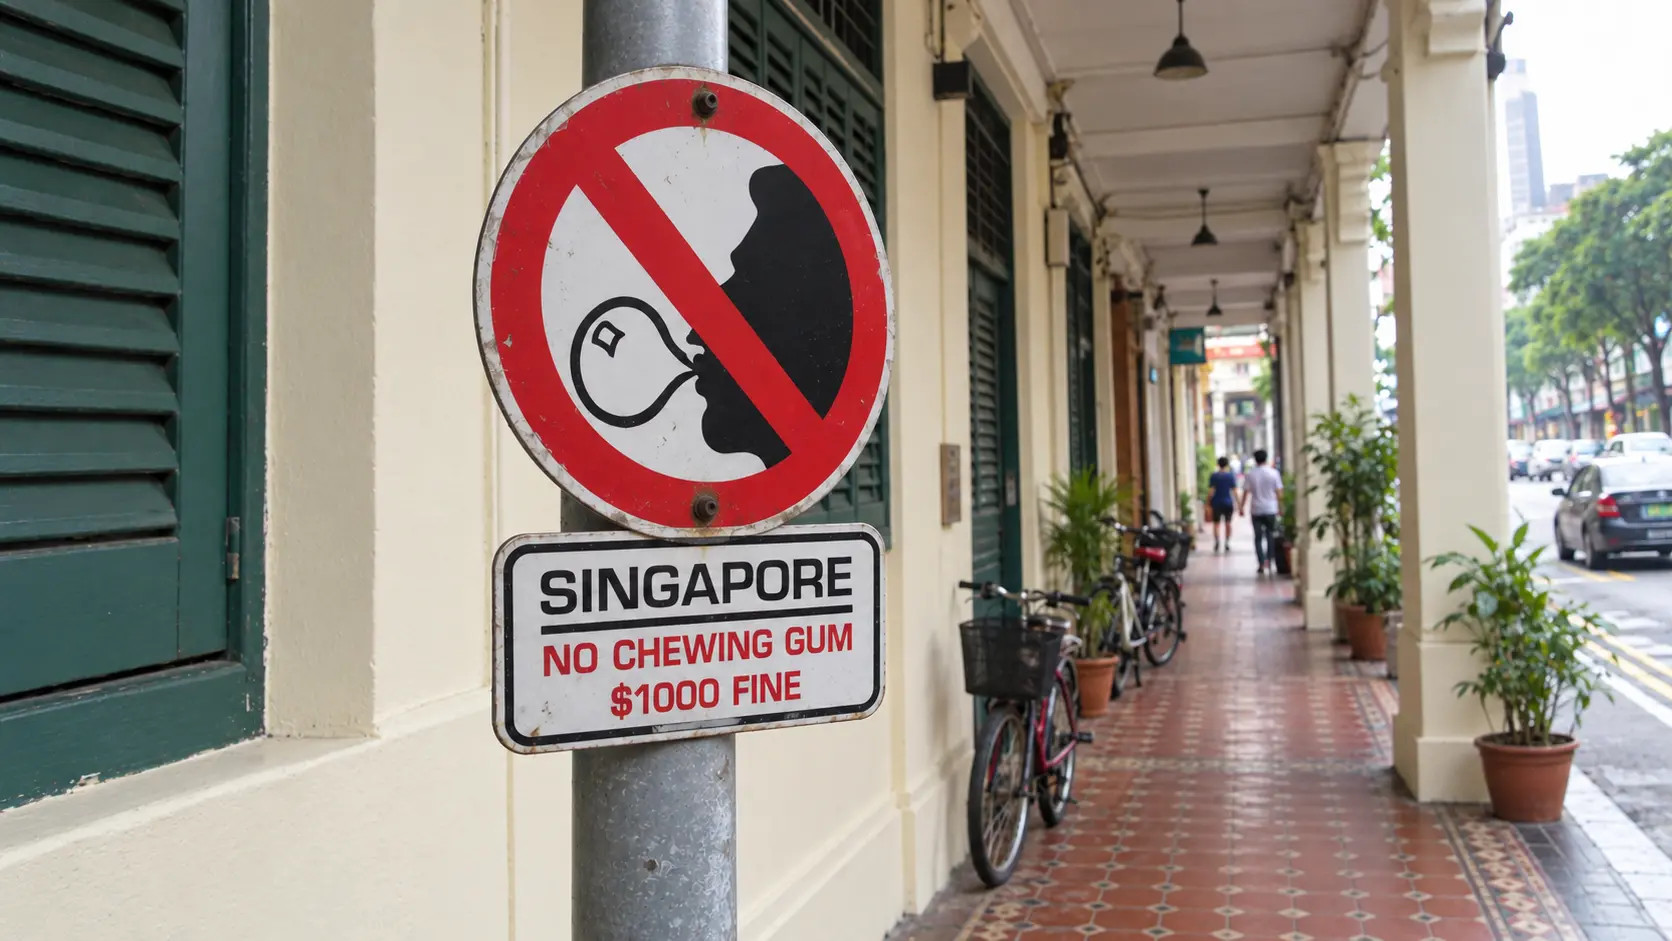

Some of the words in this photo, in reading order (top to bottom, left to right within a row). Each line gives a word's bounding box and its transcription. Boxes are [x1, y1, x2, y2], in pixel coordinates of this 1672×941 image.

[540, 556, 853, 616] SINGAPORE
[543, 642, 598, 677] NO
[613, 628, 773, 671] CHEWING
[784, 622, 853, 656] GUM
[610, 678, 719, 720] $1000
[733, 670, 801, 706] FINE
